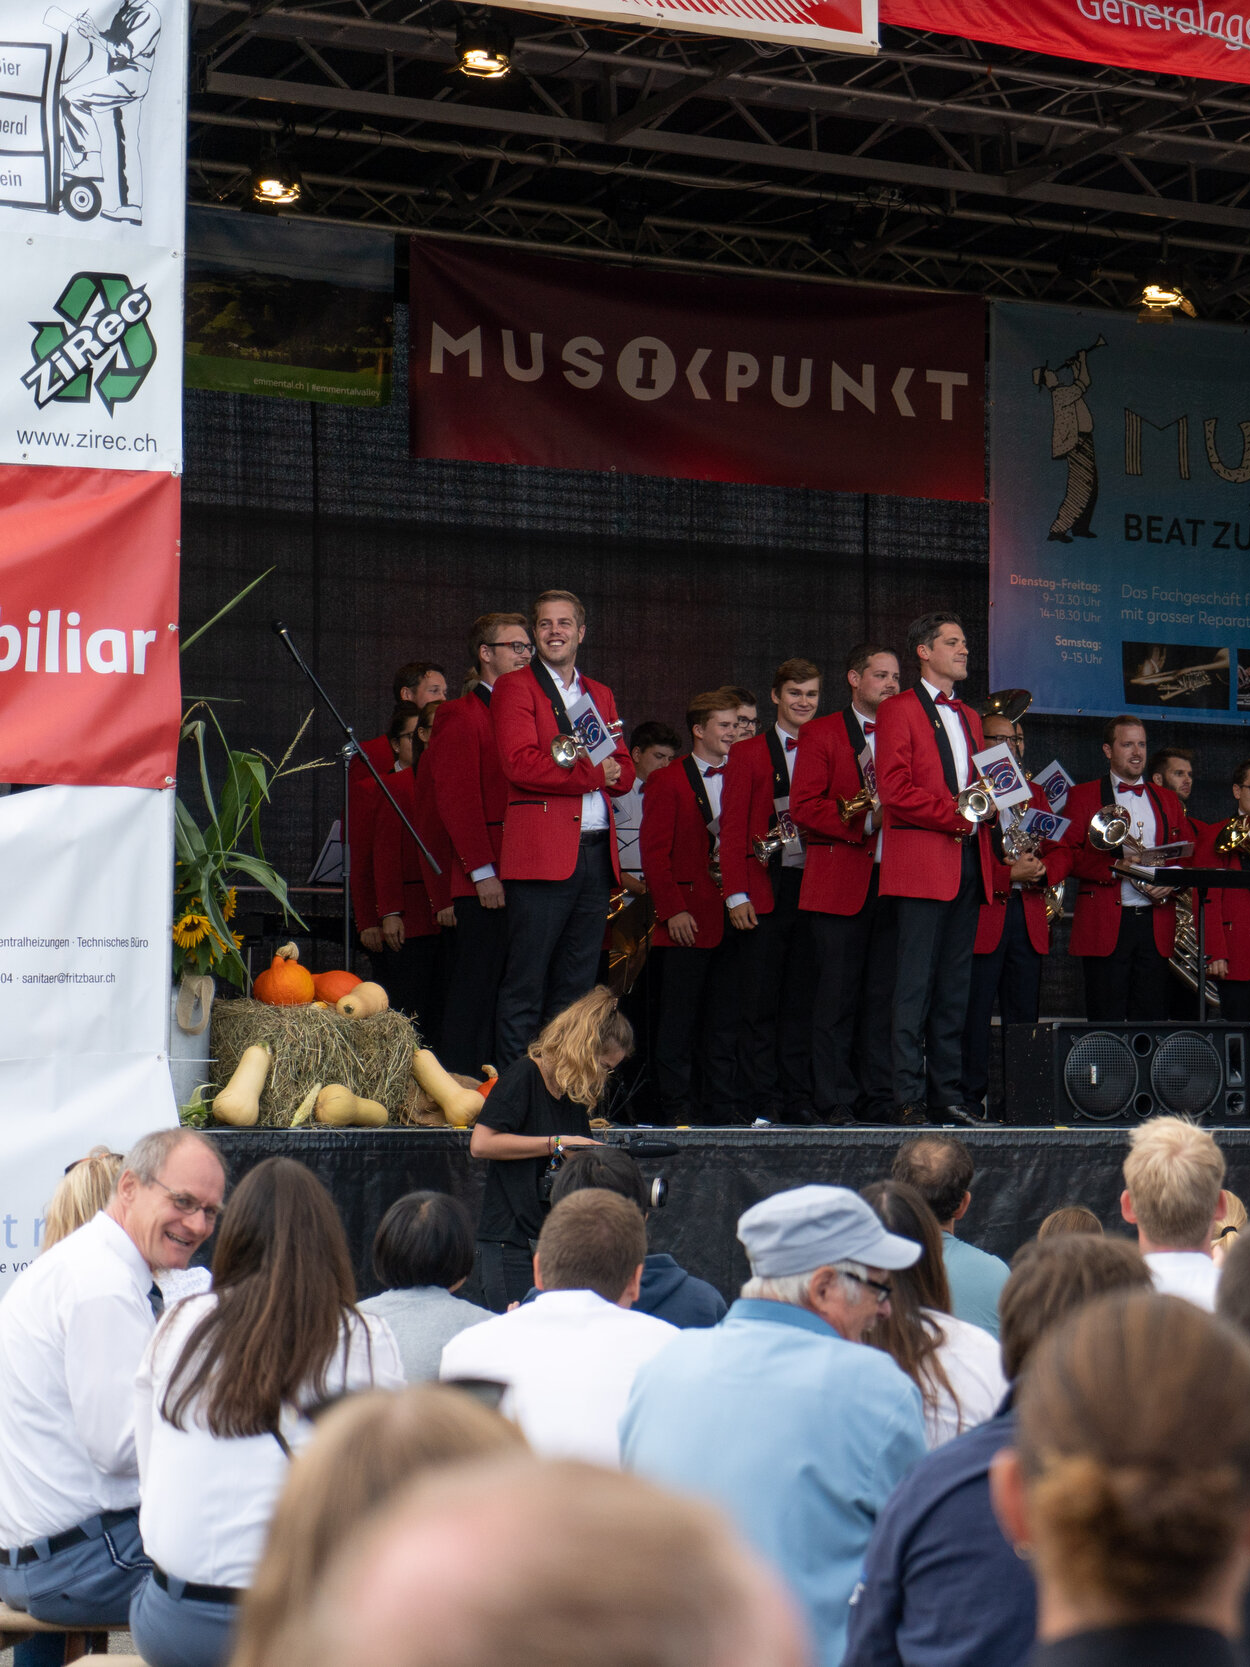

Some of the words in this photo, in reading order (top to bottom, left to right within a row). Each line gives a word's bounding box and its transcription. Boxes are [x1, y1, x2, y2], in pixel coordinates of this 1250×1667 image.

[0, 57, 21, 76] ier
[16, 429, 157, 453] www.zirec.ch
[1124, 513, 1205, 546] BEAT
[1121, 583, 1149, 600] Das
[1152, 586, 1242, 607] Fachgeschäft
[1083, 610, 1102, 623] Uhr
[1120, 608, 1144, 621] mit
[1147, 610, 1196, 625] grosser
[1055, 635, 1102, 651] Samstag:
[1085, 653, 1103, 665] Uhr
[77, 936, 129, 948] Technisches
[130, 936, 149, 948] Büro
[22, 972, 116, 984] sanitaer@fritzbaur.ch
